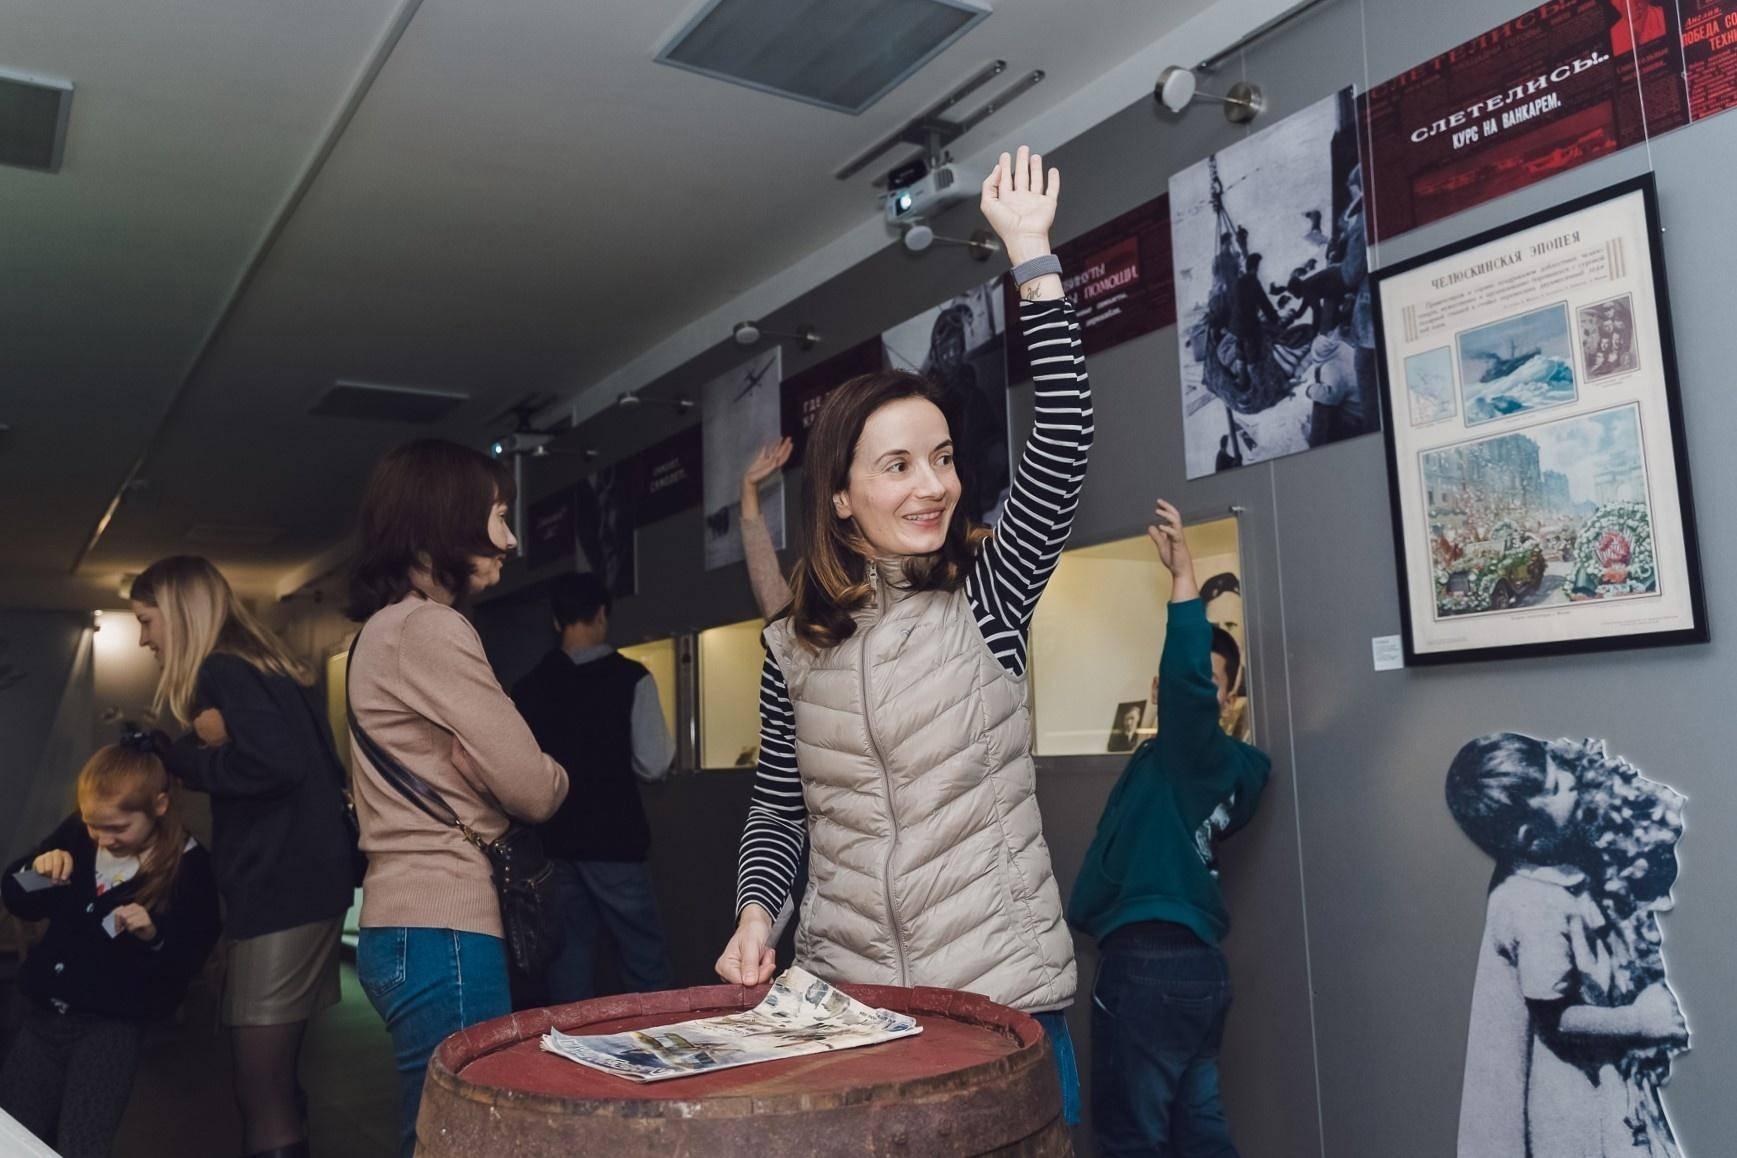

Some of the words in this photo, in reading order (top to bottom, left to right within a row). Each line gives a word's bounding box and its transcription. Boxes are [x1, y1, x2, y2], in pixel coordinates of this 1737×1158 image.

[1410, 51, 1610, 143] СЛЕТЕЛИСЬ!..
[1452, 125, 1479, 150] КУРС
[1483, 120, 1498, 137] НА
[1502, 92, 1562, 129] ВАНКАРЕМ.
[1431, 250, 1522, 290] ЧЕЛЮСКИНСКАЯ
[1529, 230, 1580, 257] ЭПОПЕЯ
